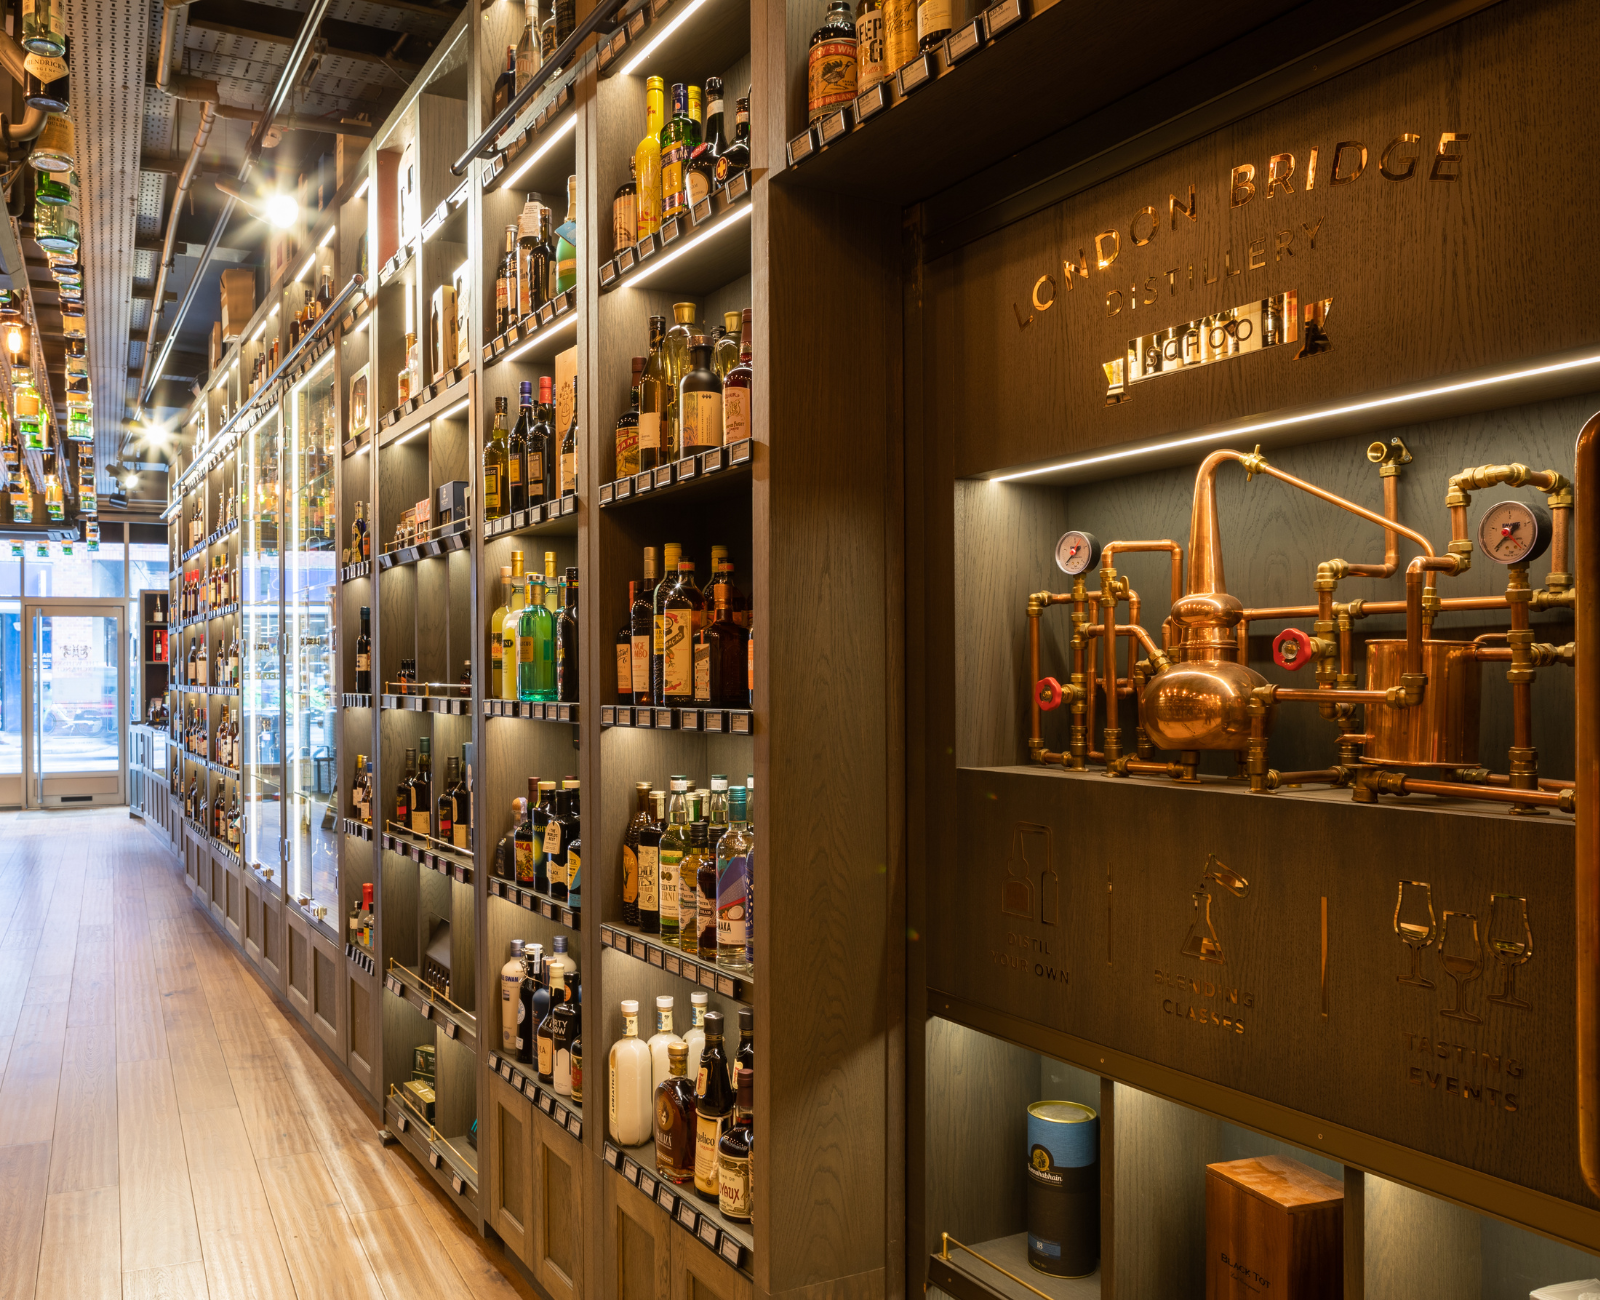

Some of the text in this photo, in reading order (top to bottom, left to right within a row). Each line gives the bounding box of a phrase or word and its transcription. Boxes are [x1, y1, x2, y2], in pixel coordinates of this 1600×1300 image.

[825, 92, 856, 104] IRELAND
[48, 115, 67, 124] ONKEY
[1012, 132, 1472, 332] LONDON BRIDGE
[1106, 215, 1326, 318] DISTILLERY
[1007, 931, 1052, 955] DISTIL
[990, 949, 1070, 985] YOUR OWN
[1154, 968, 1255, 1009] BLENDING
[1162, 998, 1245, 1035] CLASSES
[1402, 1031, 1525, 1080] TASTING
[1408, 1065, 1519, 1112] EVENTS
[1221, 1252, 1251, 1278] BLACK
[1253, 1271, 1272, 1289] TOT
